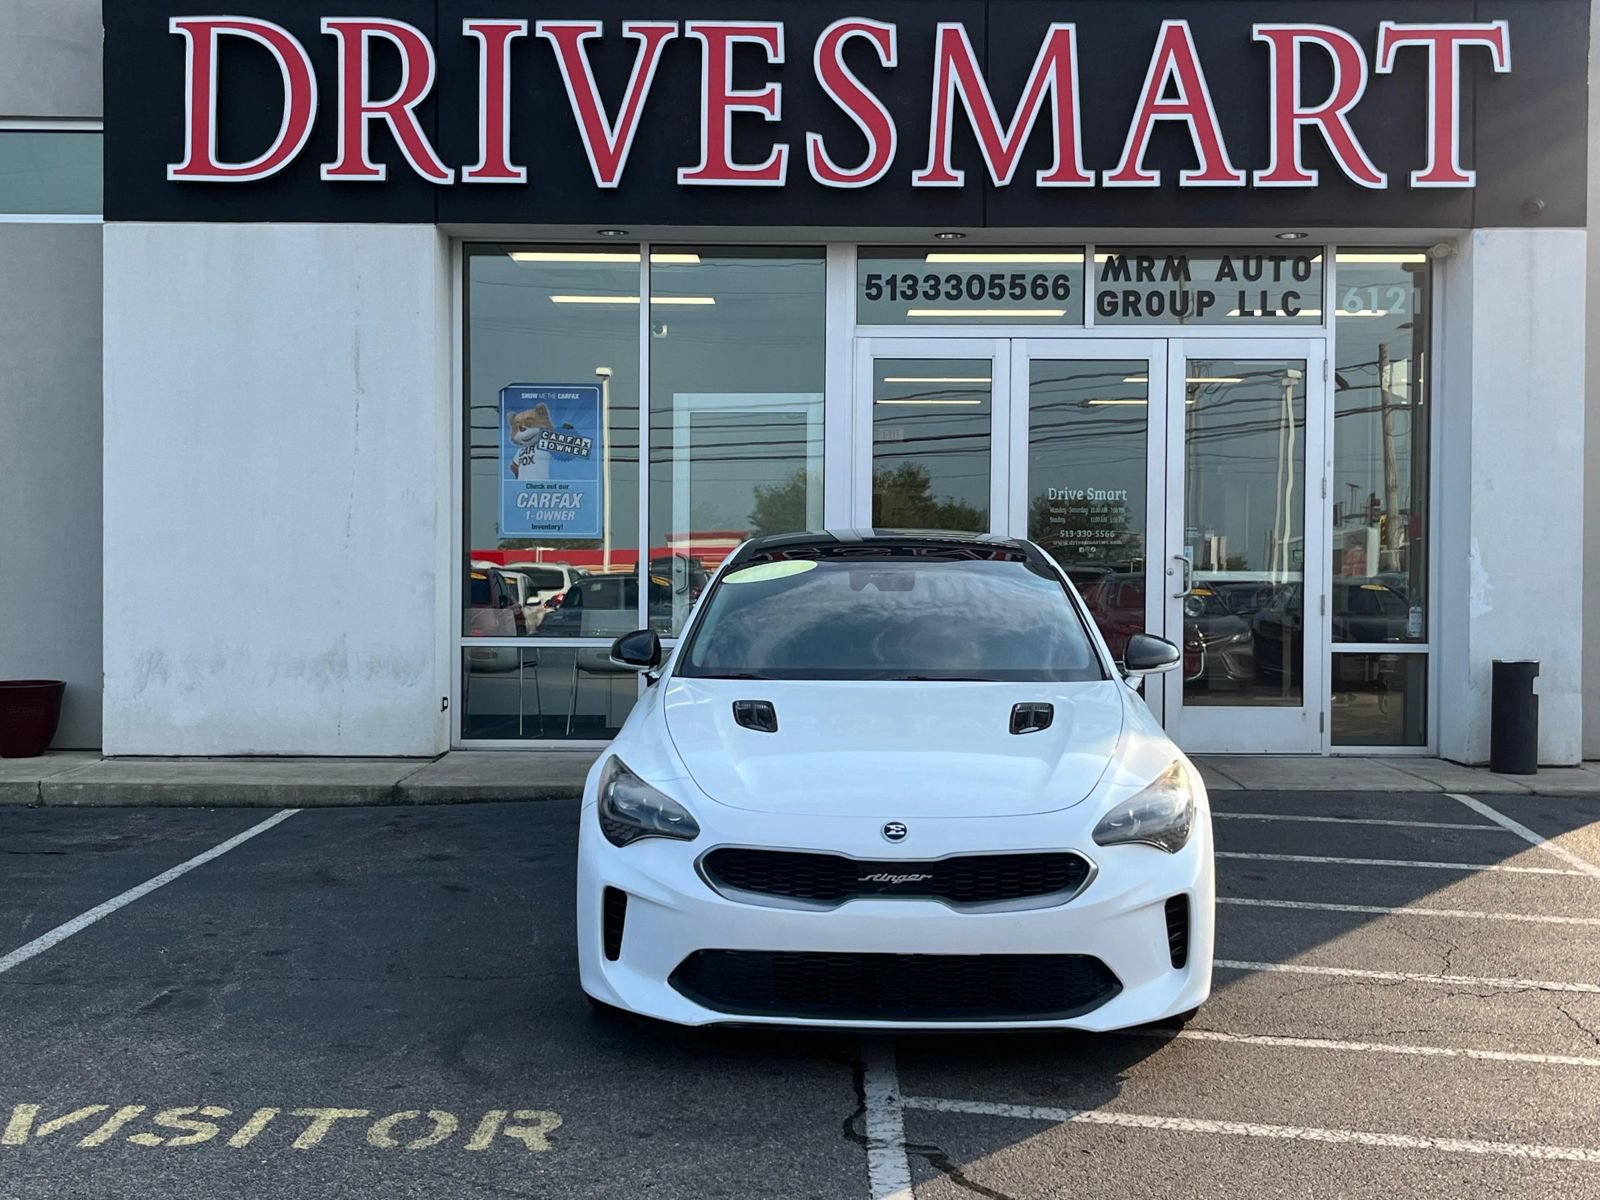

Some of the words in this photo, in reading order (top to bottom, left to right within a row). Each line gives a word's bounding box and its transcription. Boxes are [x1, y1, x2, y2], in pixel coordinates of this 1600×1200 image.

[167, 15, 1511, 189] DRIVESMART
[1101, 255, 1192, 282] MRM
[1215, 255, 1312, 282] AUTO
[865, 274, 1070, 301] 5133305566
[1342, 286, 1421, 314] 6121
[1097, 290, 1215, 317] GROUP
[1238, 290, 1301, 317] LLC
[542, 431, 591, 447] CARFAX
[516, 491, 584, 509] CARFAX
[1048, 487, 1084, 501] Drive
[1086, 487, 1128, 501] Smart
[525, 510, 576, 521] 1-OWNER
[1060, 530, 1116, 538] 513-330-5566
[0, 1103, 563, 1152] VISITOR
